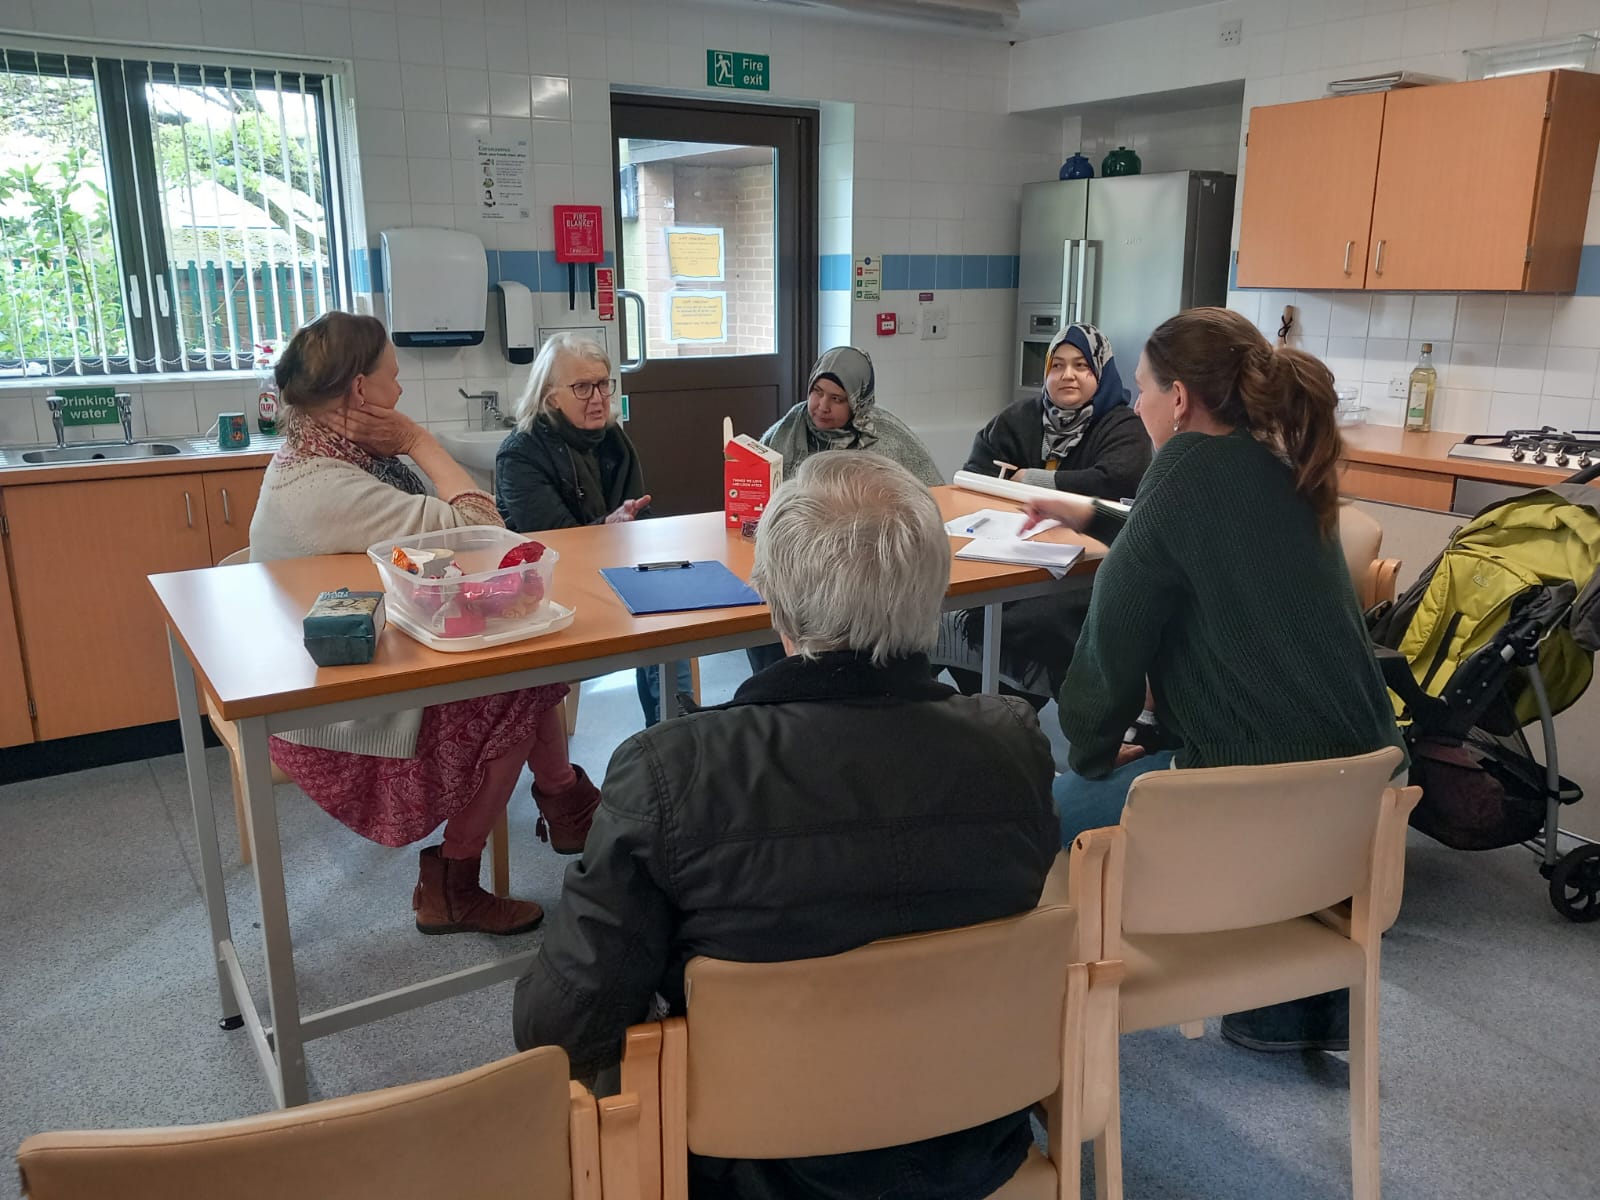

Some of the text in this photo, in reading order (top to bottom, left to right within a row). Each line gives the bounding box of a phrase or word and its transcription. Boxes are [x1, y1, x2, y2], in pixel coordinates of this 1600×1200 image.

[742, 58, 763, 71] Fire
[743, 74, 763, 86] exit
[566, 219, 594, 227] BLANKET
[70, 408, 107, 419] water
